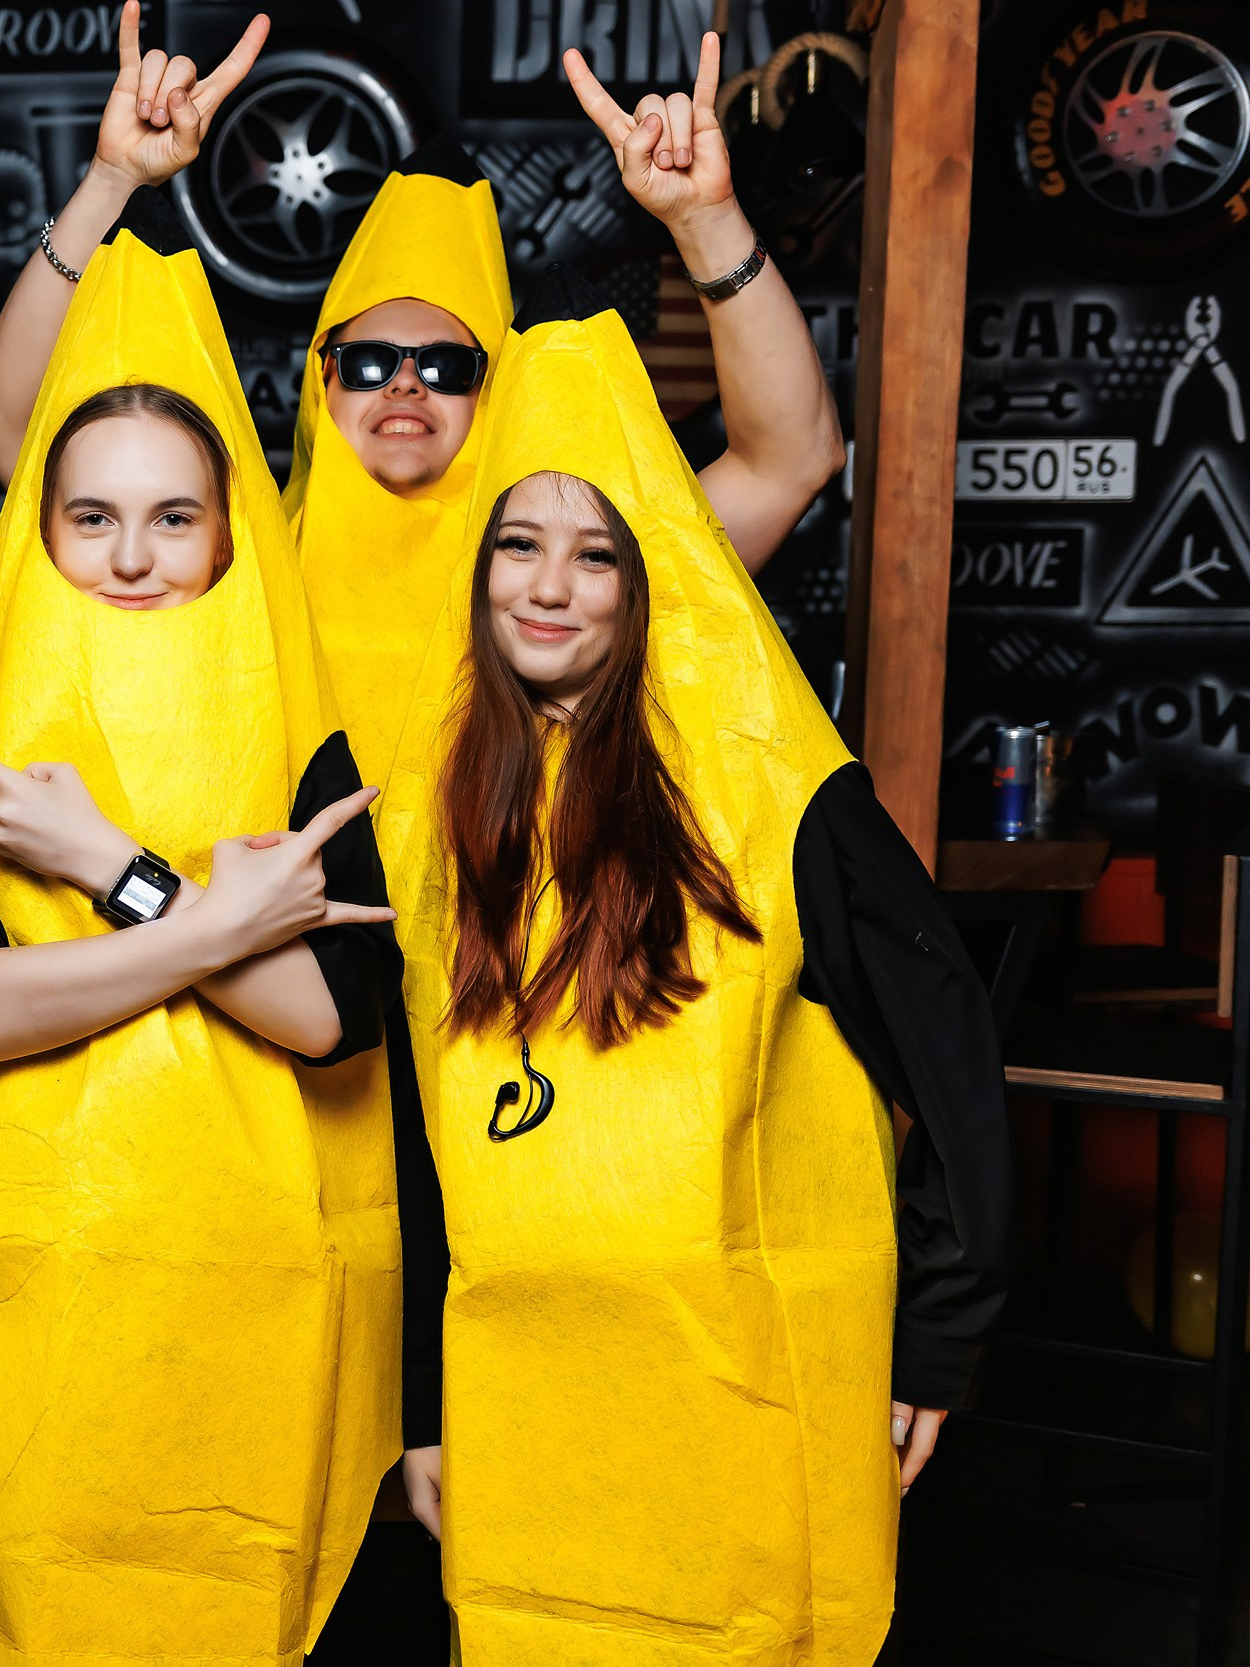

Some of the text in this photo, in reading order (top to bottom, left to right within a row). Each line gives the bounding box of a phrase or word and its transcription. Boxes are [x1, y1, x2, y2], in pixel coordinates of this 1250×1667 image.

[968, 301, 1117, 359] CAR
[971, 445, 1117, 490] 550 56
